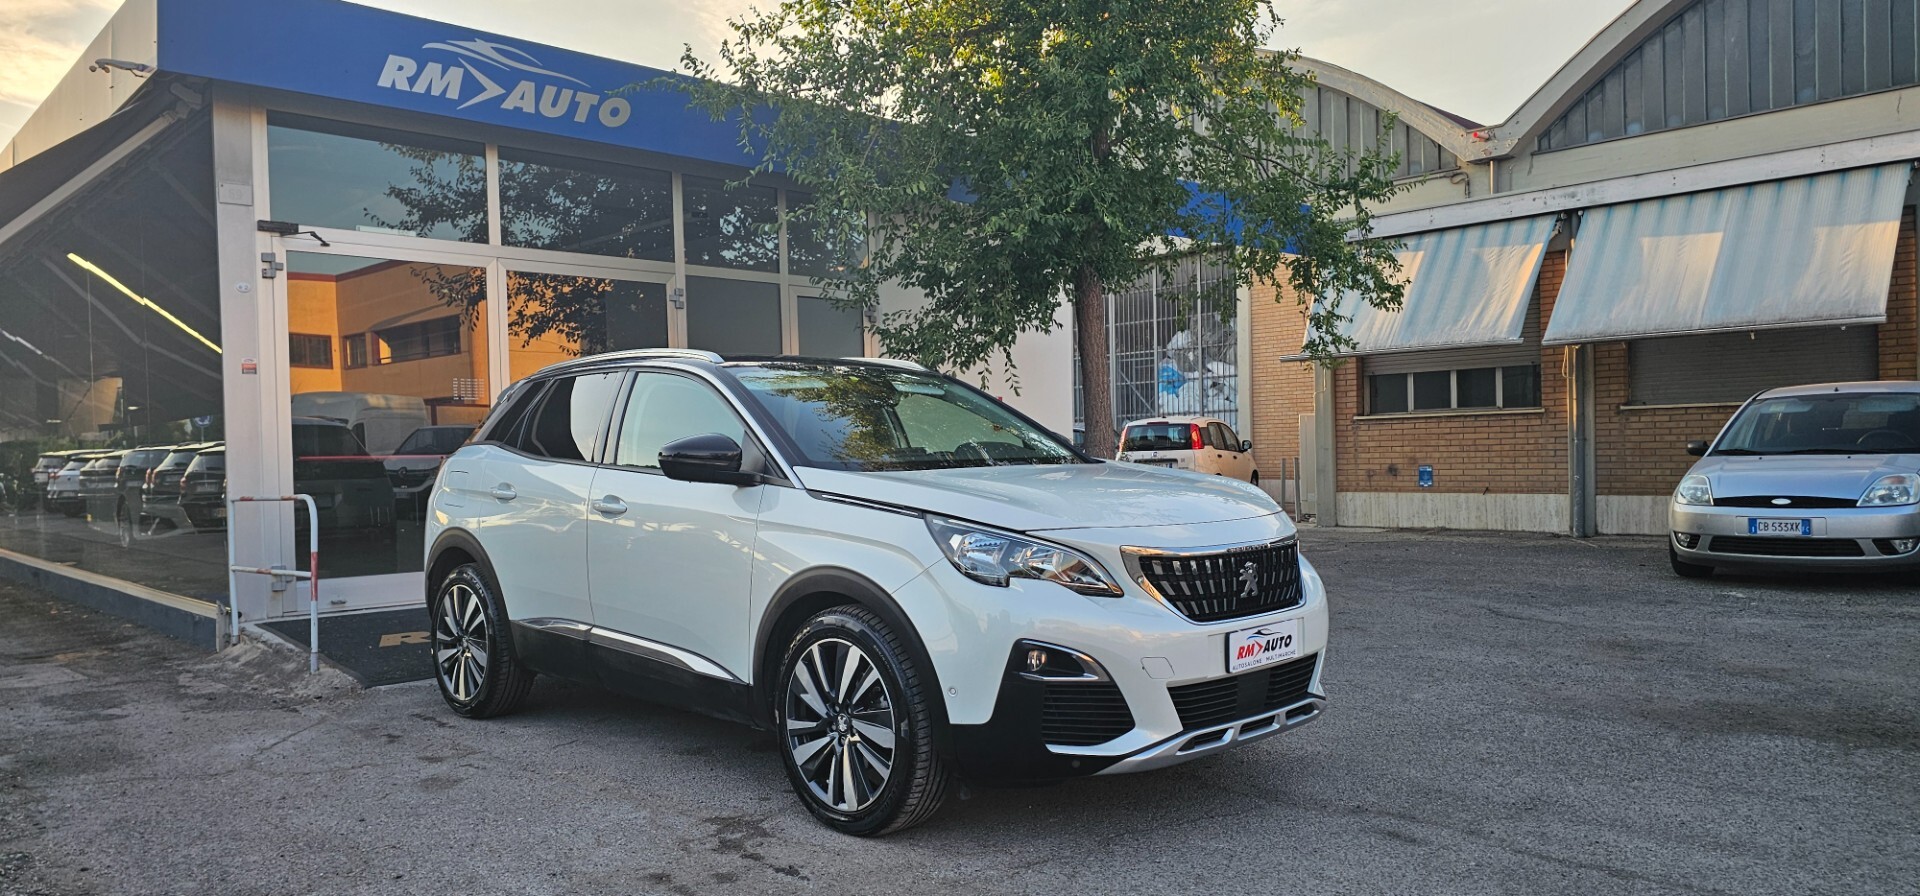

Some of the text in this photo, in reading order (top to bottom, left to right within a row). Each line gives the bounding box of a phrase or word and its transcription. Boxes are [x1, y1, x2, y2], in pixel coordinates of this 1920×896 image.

[500, 80, 632, 128] AUTO
[1758, 521, 1769, 532] CB
[1771, 522, 1801, 532] 533XK
[1262, 634, 1293, 654] AUTO
[1232, 649, 1296, 670] AUTOSALONE MULTIMARCHE
